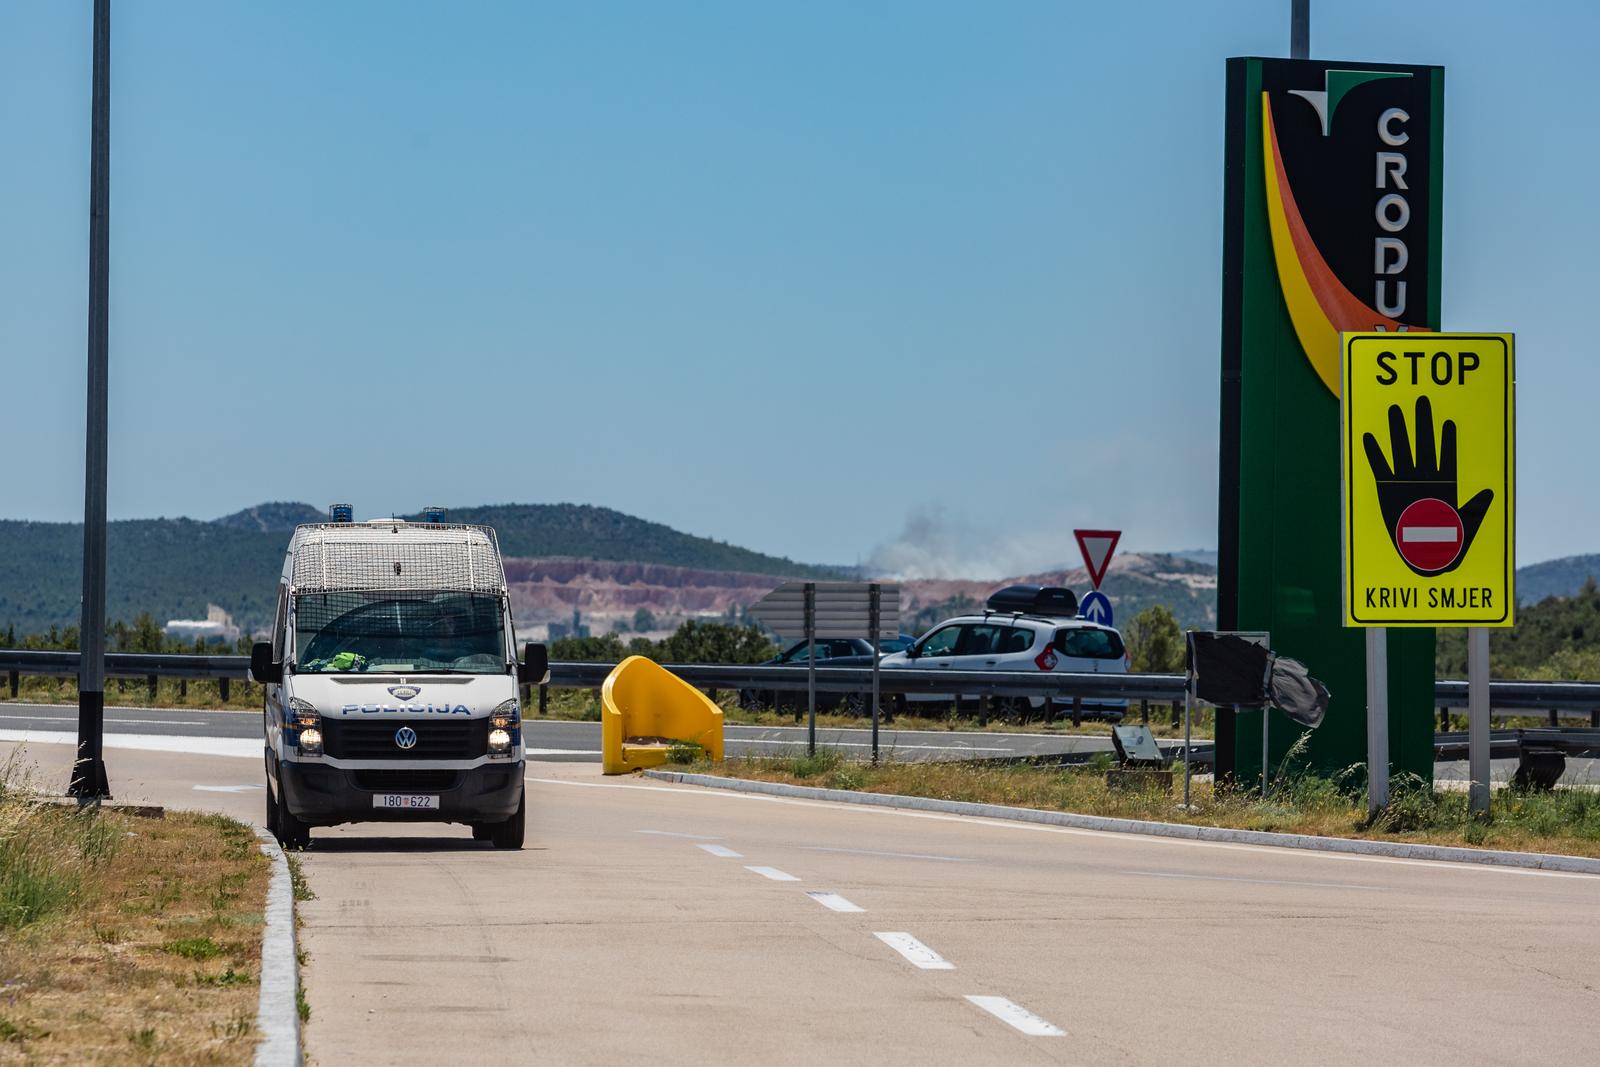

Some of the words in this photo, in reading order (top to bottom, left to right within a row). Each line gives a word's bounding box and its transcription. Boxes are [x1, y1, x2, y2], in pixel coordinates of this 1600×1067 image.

[1374, 107, 1411, 332] CRODU
[1376, 351, 1480, 386] STOP
[1366, 587, 1417, 608] KRIVI
[1428, 587, 1493, 608] SMJER
[342, 703, 471, 715] POLICIJA
[396, 727, 416, 749] VW
[383, 795, 402, 807] 180
[410, 796, 431, 808] 622
